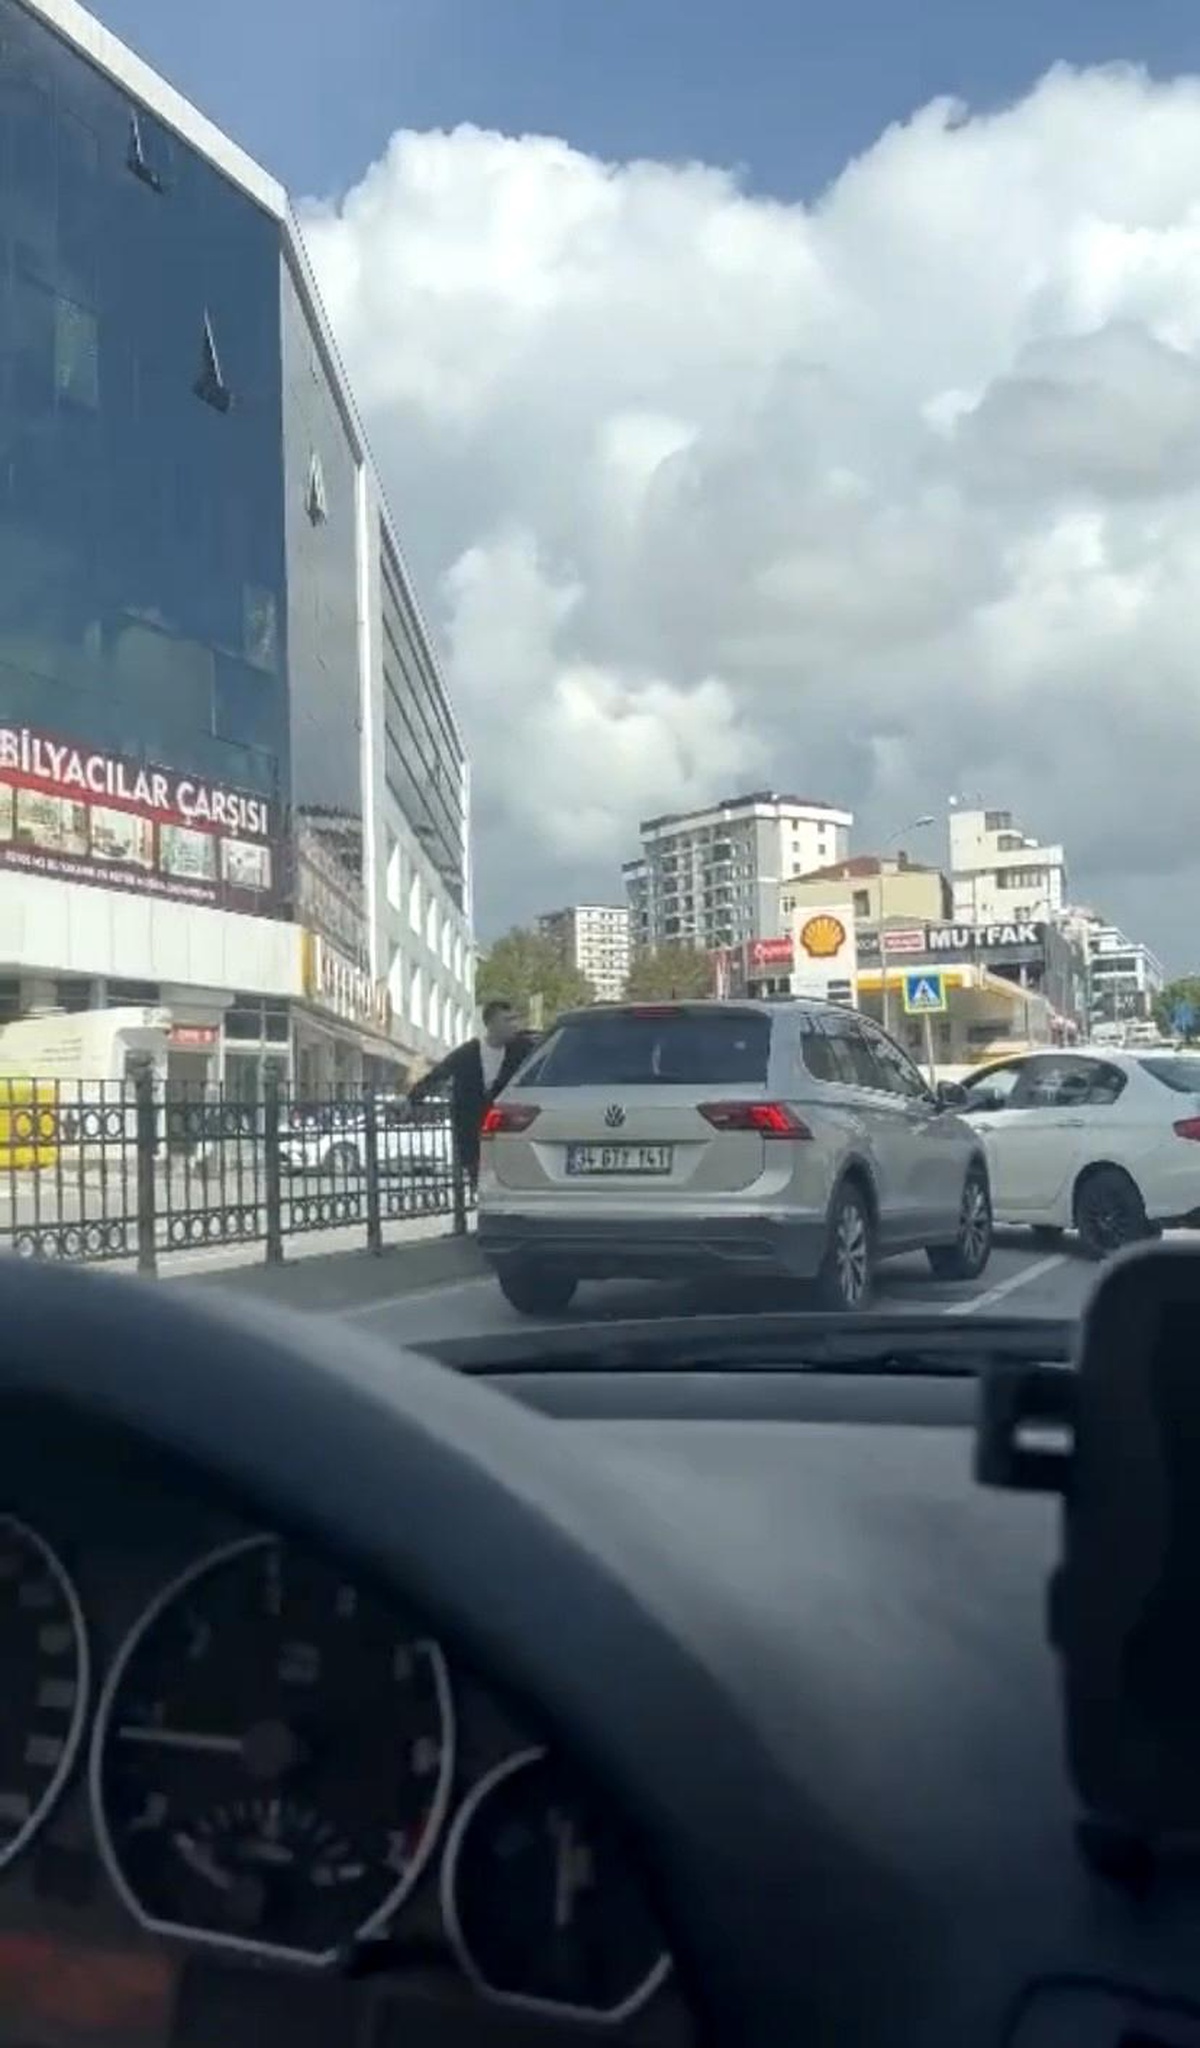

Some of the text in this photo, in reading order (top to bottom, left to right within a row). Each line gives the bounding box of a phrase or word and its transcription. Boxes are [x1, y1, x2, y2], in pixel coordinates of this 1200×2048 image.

[0, 729, 268, 837] BİLYACILAR ÇARŞISI
[929, 924, 1037, 949] MUTFAK
